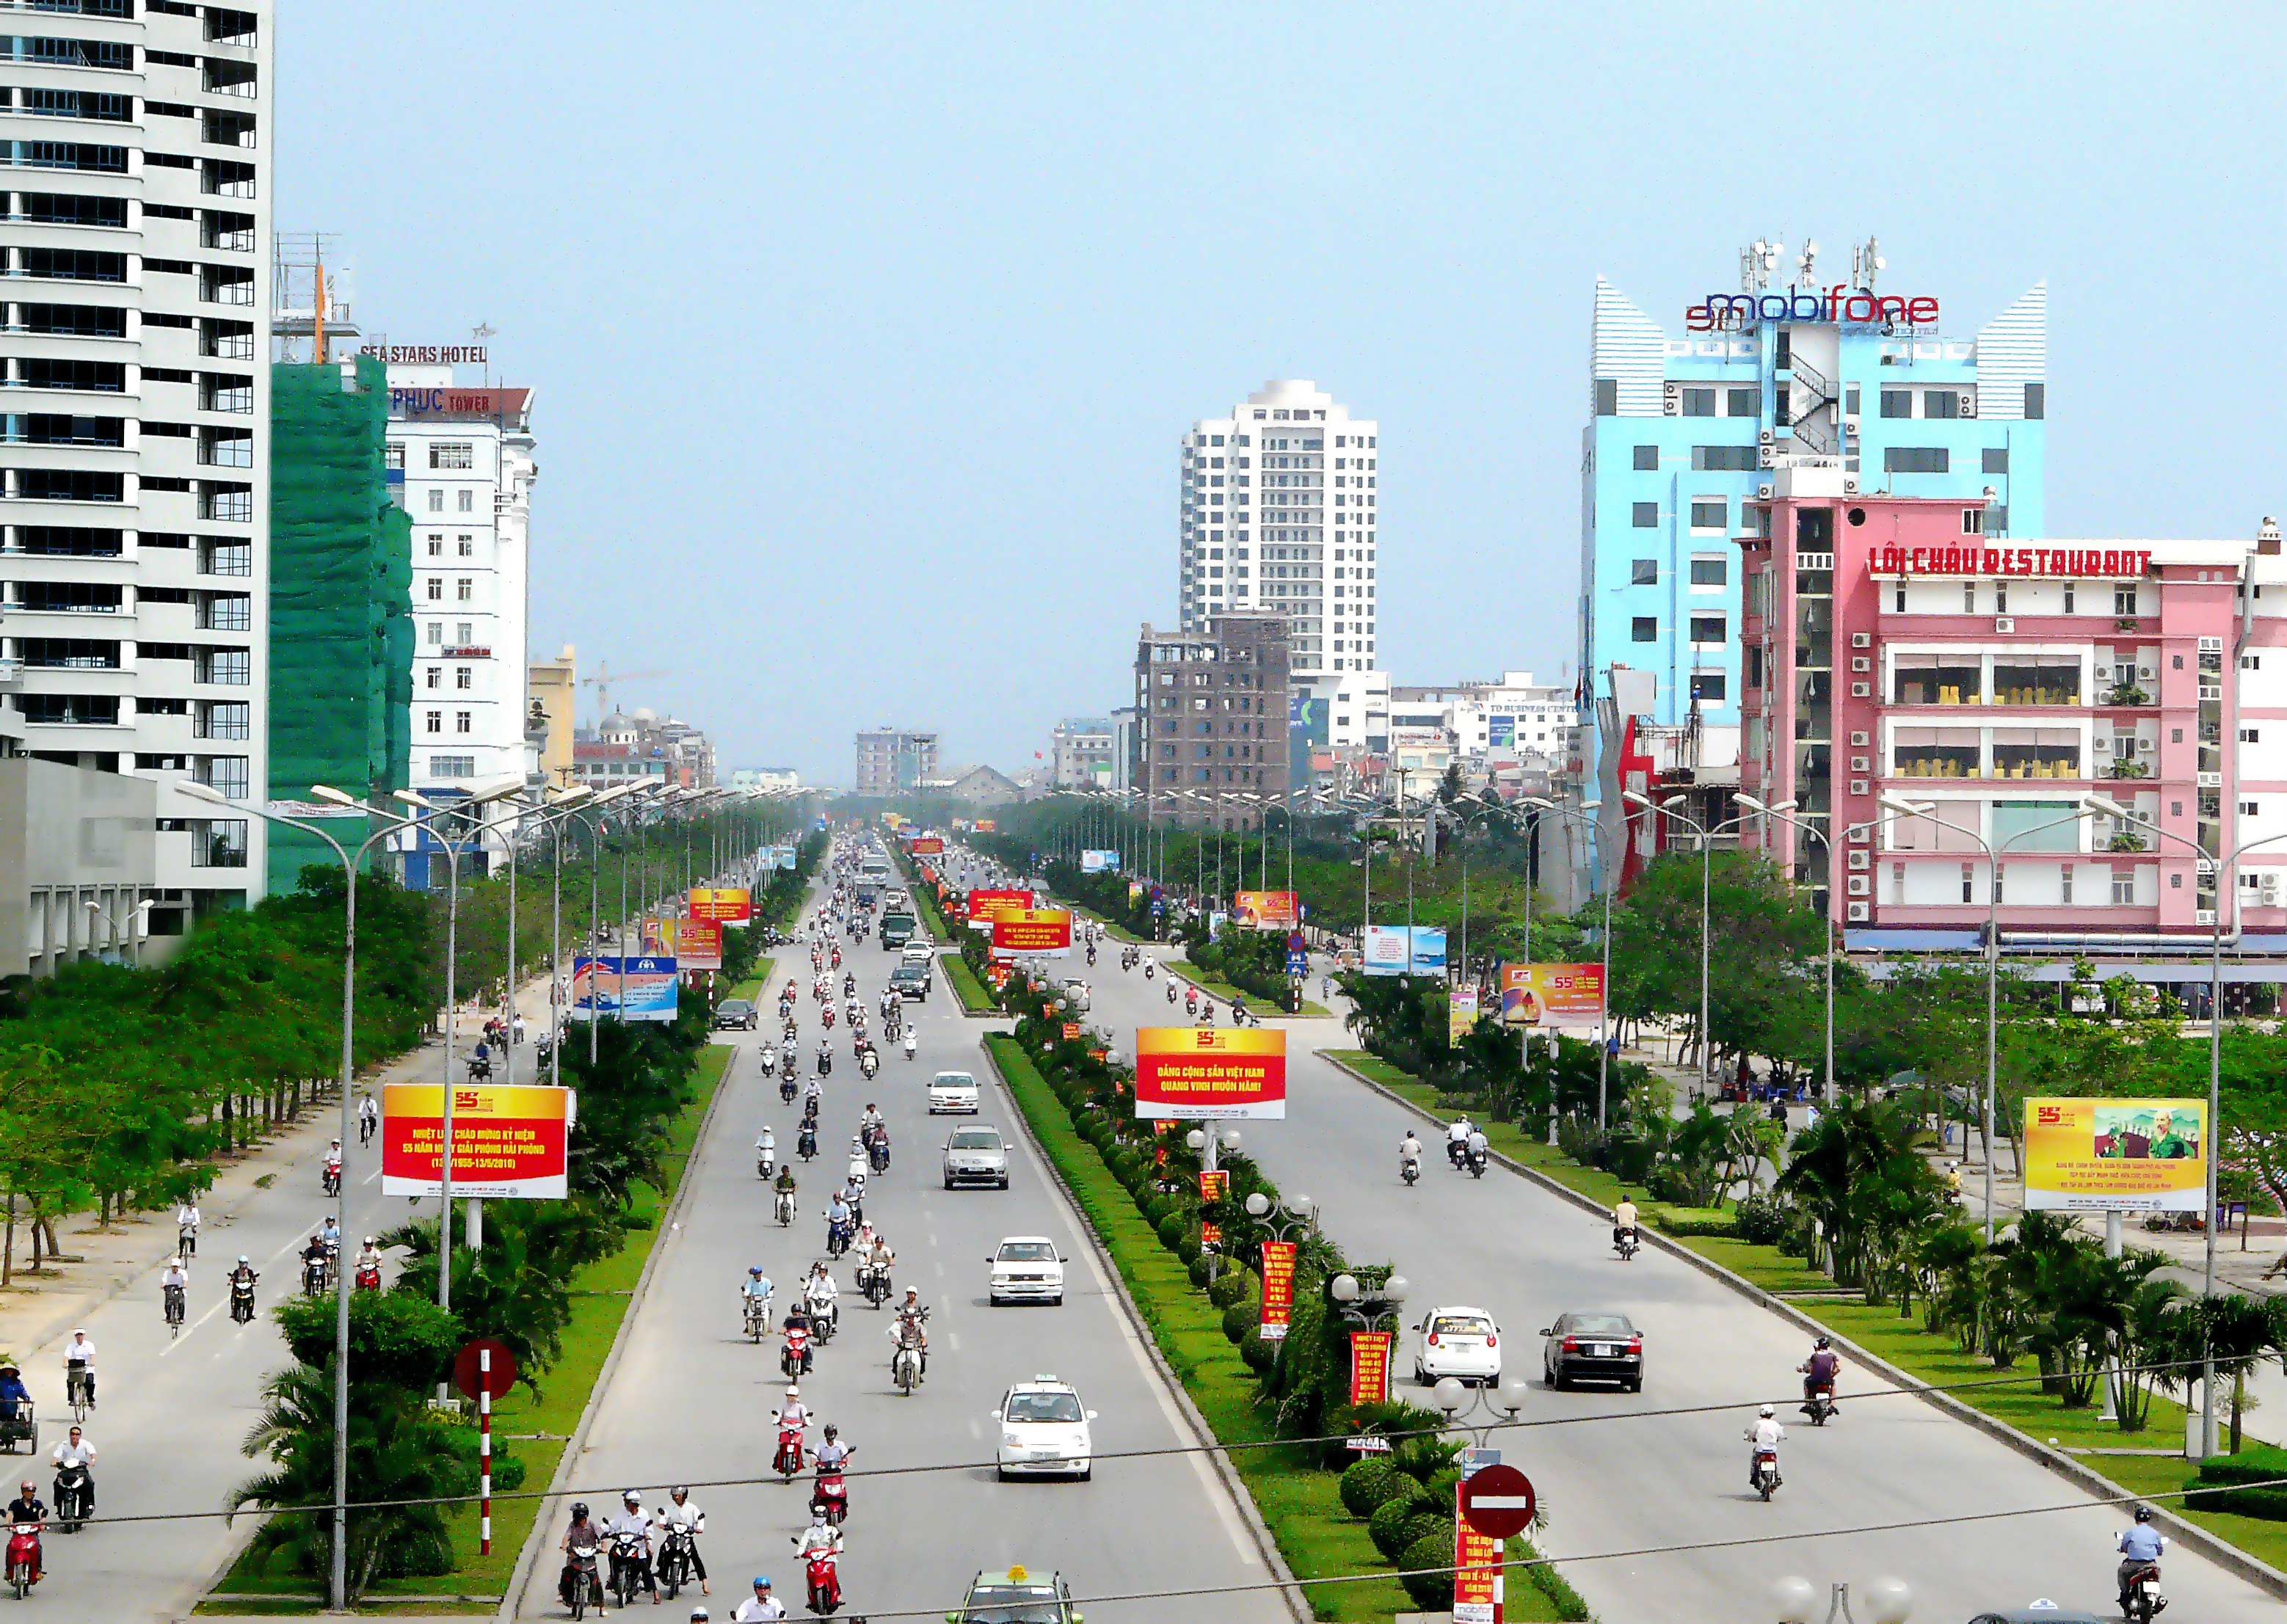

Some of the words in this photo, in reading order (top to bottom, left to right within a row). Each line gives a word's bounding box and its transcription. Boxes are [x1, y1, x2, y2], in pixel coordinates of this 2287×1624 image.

[1706, 284, 1938, 322] mobifone
[391, 346, 437, 363] STARS
[441, 346, 487, 363] HOTEL
[449, 396, 490, 412] TOWER
[1983, 549, 2152, 577] RESTAURANT
[1182, 1065, 1205, 1079] CỘNG
[1207, 1064, 1224, 1077] SẢN
[1226, 1066, 1243, 1079] VIỆT
[1245, 1068, 1265, 1078] NAM
[1160, 1081, 1189, 1092] QUANG
[1190, 1081, 1210, 1092] VINH
[414, 1140, 433, 1153] NĂM
[435, 1143, 456, 1154] NY
